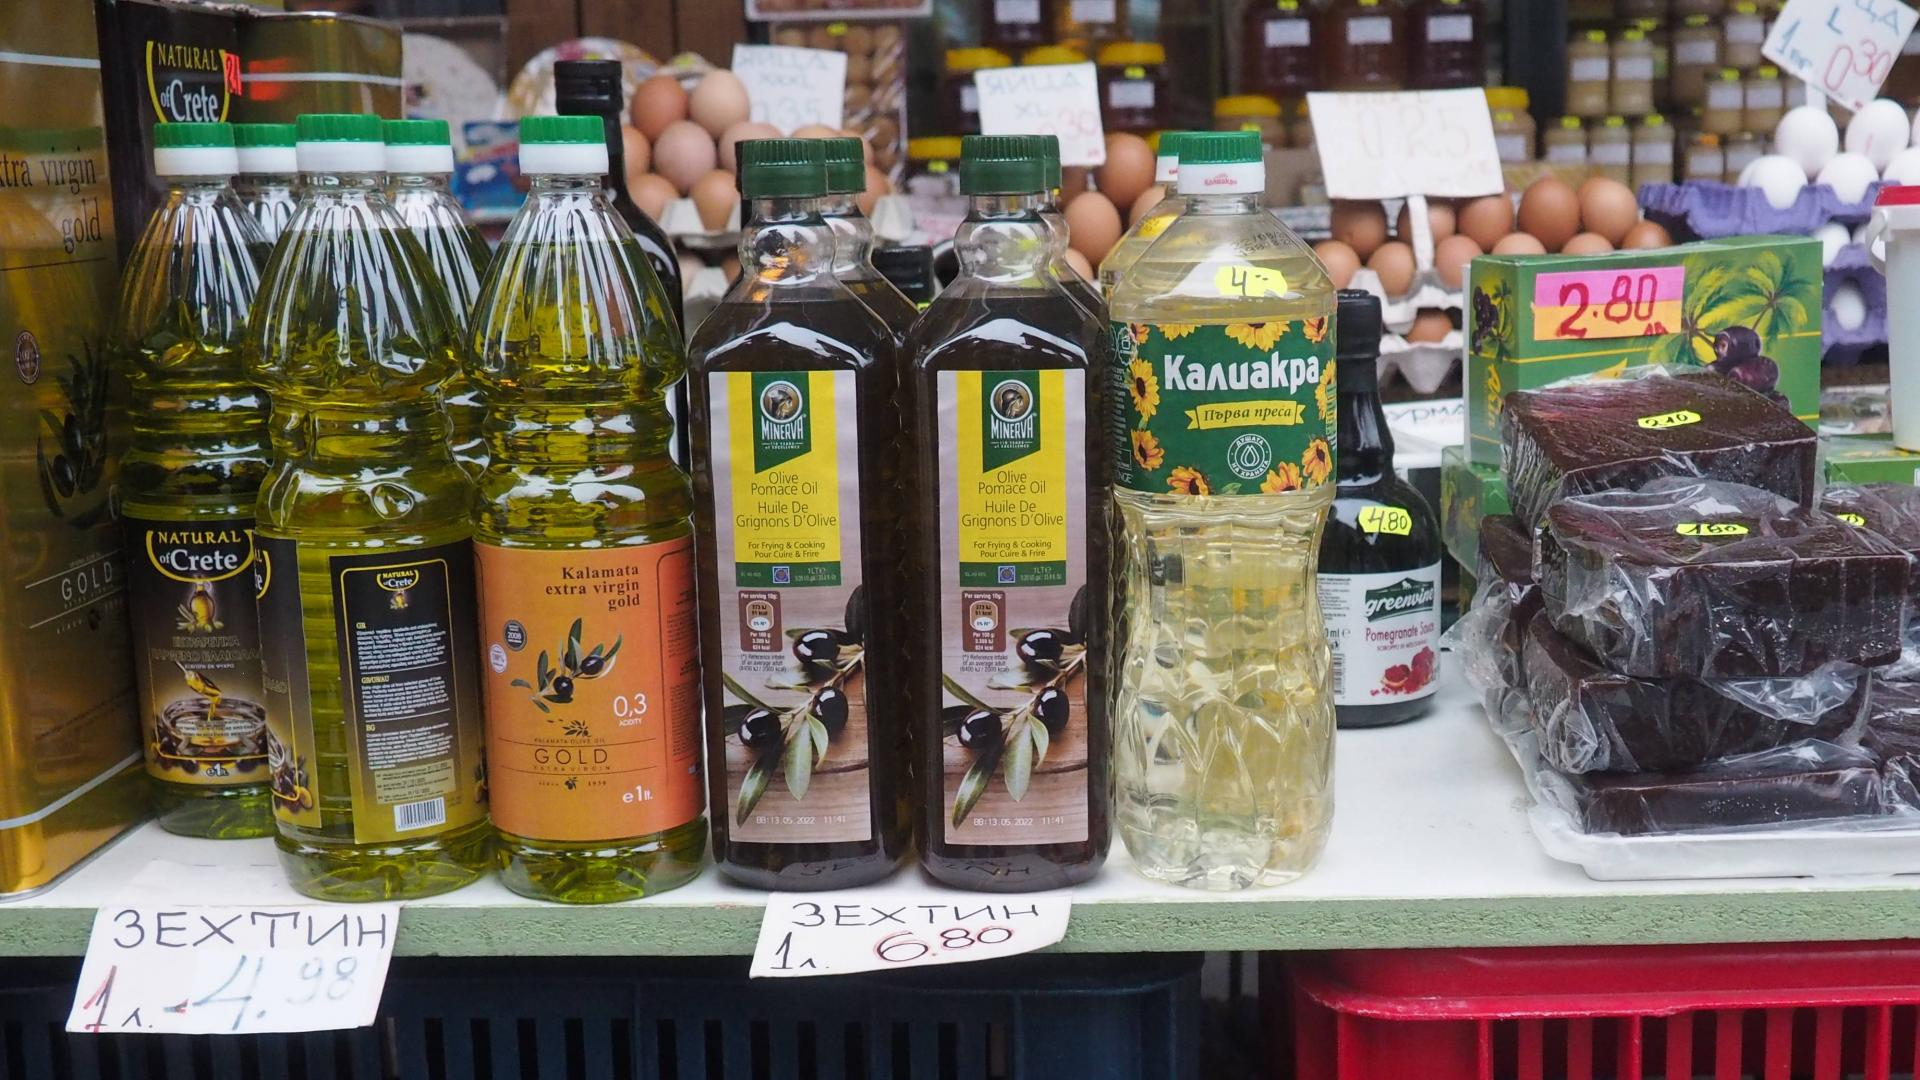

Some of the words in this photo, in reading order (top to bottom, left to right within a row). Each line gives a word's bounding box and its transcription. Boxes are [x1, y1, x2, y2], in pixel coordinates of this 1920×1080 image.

[158, 43, 218, 71] NATURAL
[160, 86, 171, 108] of
[170, 79, 219, 122] Crete
[0, 154, 33, 188] tra
[41, 146, 97, 195] virgin
[62, 197, 102, 254] gold
[1555, 273, 1658, 337] 2.80
[1163, 351, 1320, 395] Калиакра
[1203, 407, 1250, 421] Първа
[1254, 407, 1292, 420] преса
[761, 415, 804, 440] MINERVA
[990, 413, 1034, 439] MINERVA
[1236, 436, 1264, 447] ДУШАТА
[769, 471, 799, 484] Olive
[997, 470, 1027, 483] Olive
[751, 483, 798, 496] Pomace
[801, 481, 818, 495] Oil
[978, 482, 1026, 495] Pomace
[1030, 480, 1046, 494] Oil
[758, 501, 788, 514] Huile
[791, 501, 809, 514] De
[985, 500, 1016, 513] Huile
[1019, 500, 1037, 513] De
[736, 514, 790, 531] Grignons
[793, 513, 837, 527] D'Olive
[961, 513, 1017, 530] Grignons
[1020, 513, 1064, 527] D'Olive
[1368, 507, 1408, 532] 4.80
[158, 531, 241, 545] NATURAL
[748, 541, 760, 549] For
[761, 541, 784, 551] Frying
[786, 541, 792, 549] &
[793, 540, 826, 550] Cooking
[973, 541, 985, 549] For
[987, 541, 1011, 551] Frying
[1020, 540, 1052, 549] Cooking
[159, 552, 171, 564] of
[170, 549, 239, 571] Crete
[773, 550, 793, 558] Cuire
[802, 550, 820, 558] Frire
[980, 550, 998, 558] Pour
[999, 550, 1020, 558] Cuire
[61, 560, 113, 601] GOLD
[562, 564, 639, 580] Kalamata
[545, 583, 587, 595] extra
[593, 578, 640, 596] virgin
[608, 593, 641, 612] gold
[1366, 625, 1418, 644] Pomegranate
[613, 693, 648, 717] 0,3
[618, 718, 642, 727] ACIDITY
[534, 748, 608, 765] GOLD
[791, 902, 1039, 927] ЗЕХТИН
[113, 909, 387, 949] ЗЕХТИН
[875, 925, 1014, 963] 6.80
